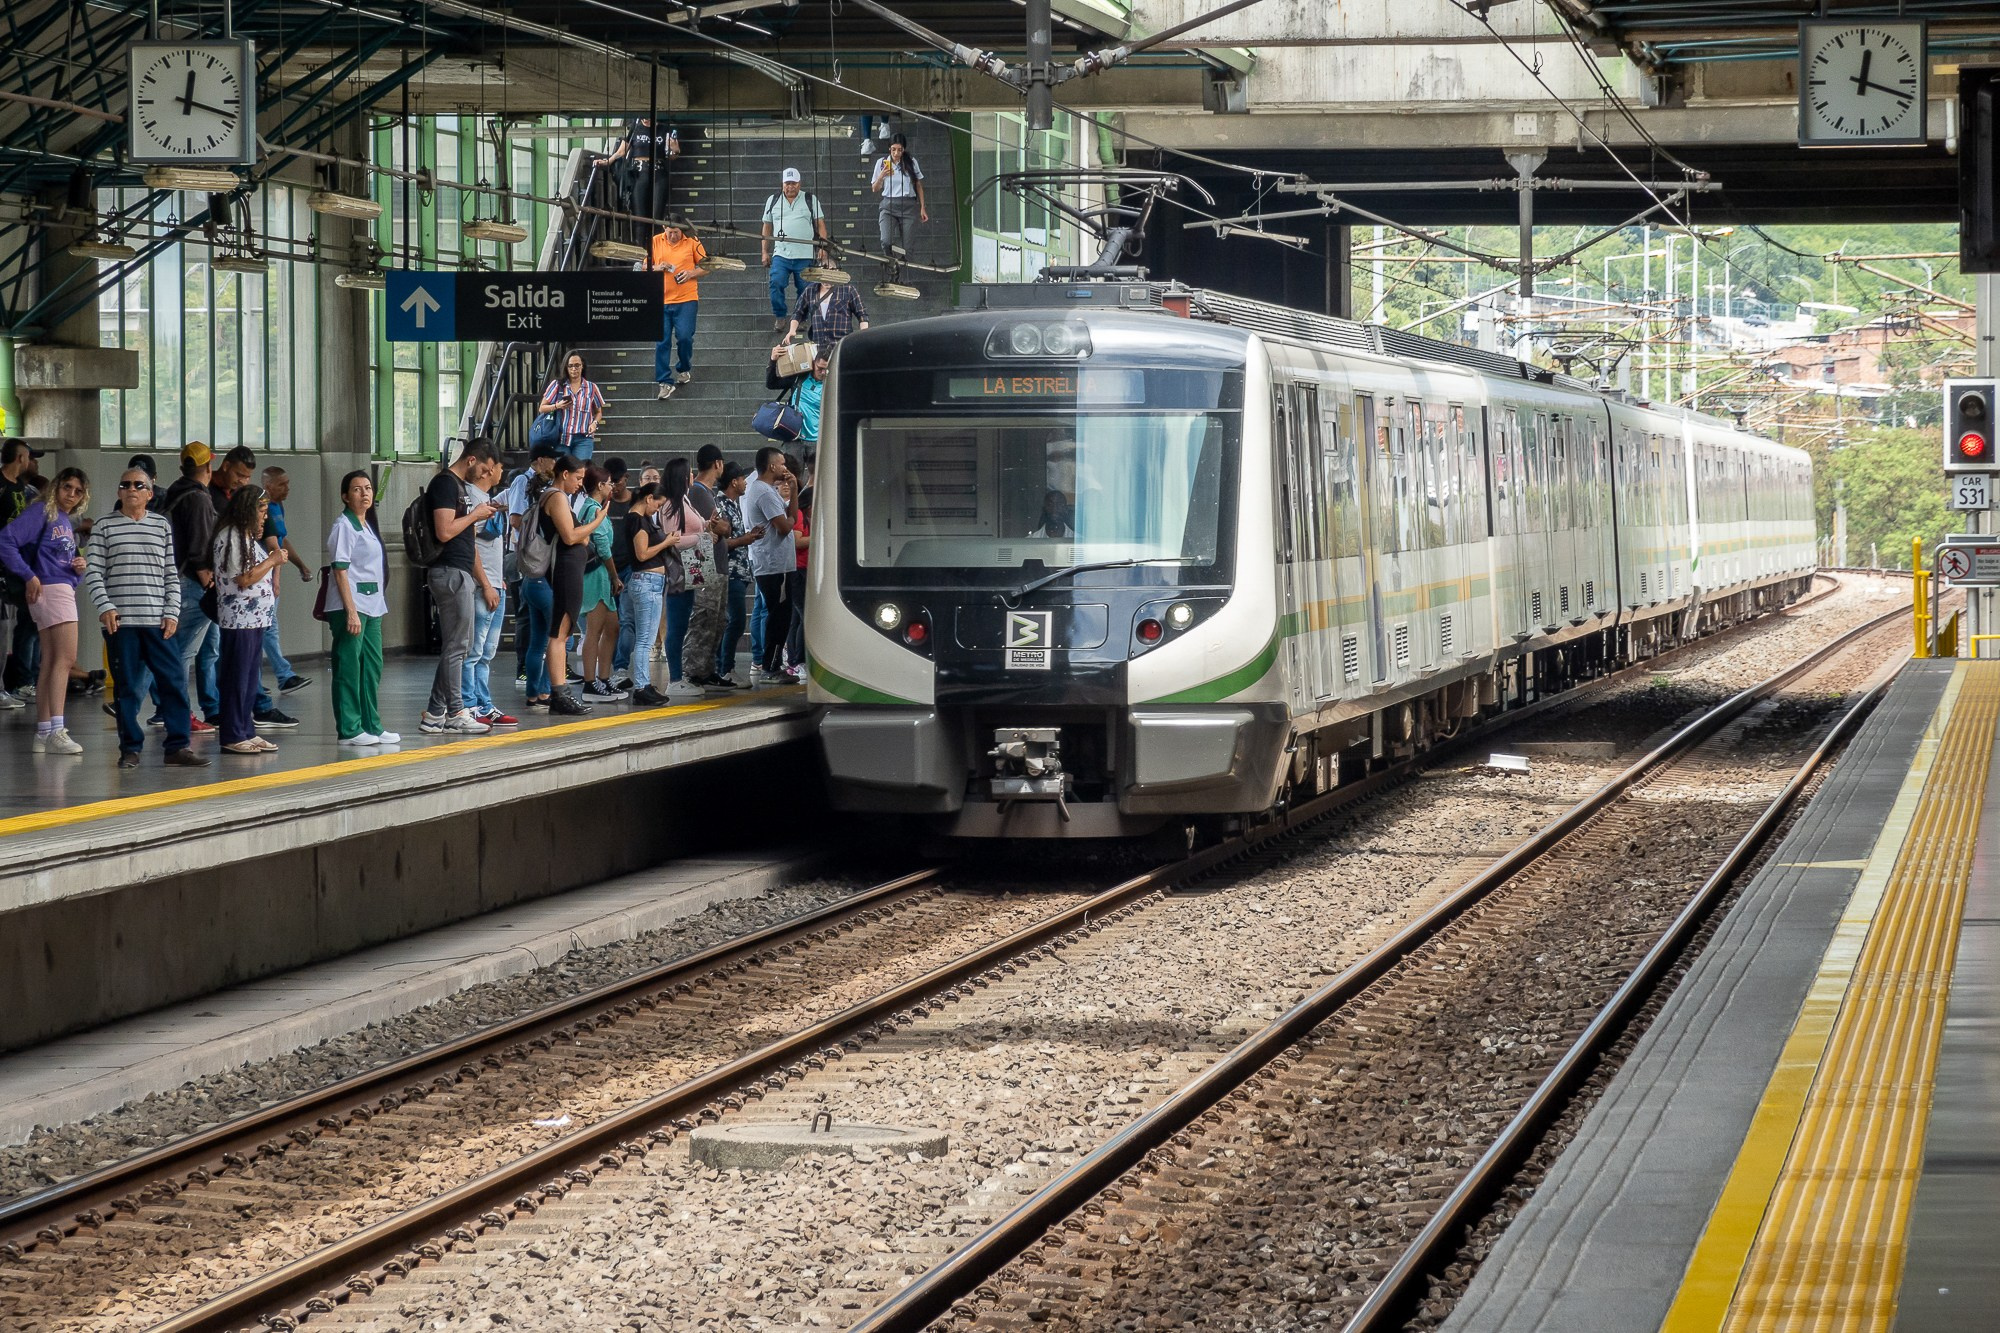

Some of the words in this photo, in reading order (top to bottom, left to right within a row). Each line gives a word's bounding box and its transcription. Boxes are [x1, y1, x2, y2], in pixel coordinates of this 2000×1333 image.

[484, 284, 565, 308] Salida
[507, 312, 542, 328] Exit
[984, 377, 1006, 394] LA
[1962, 477, 1981, 485] CAR
[1959, 488, 1984, 505] S31
